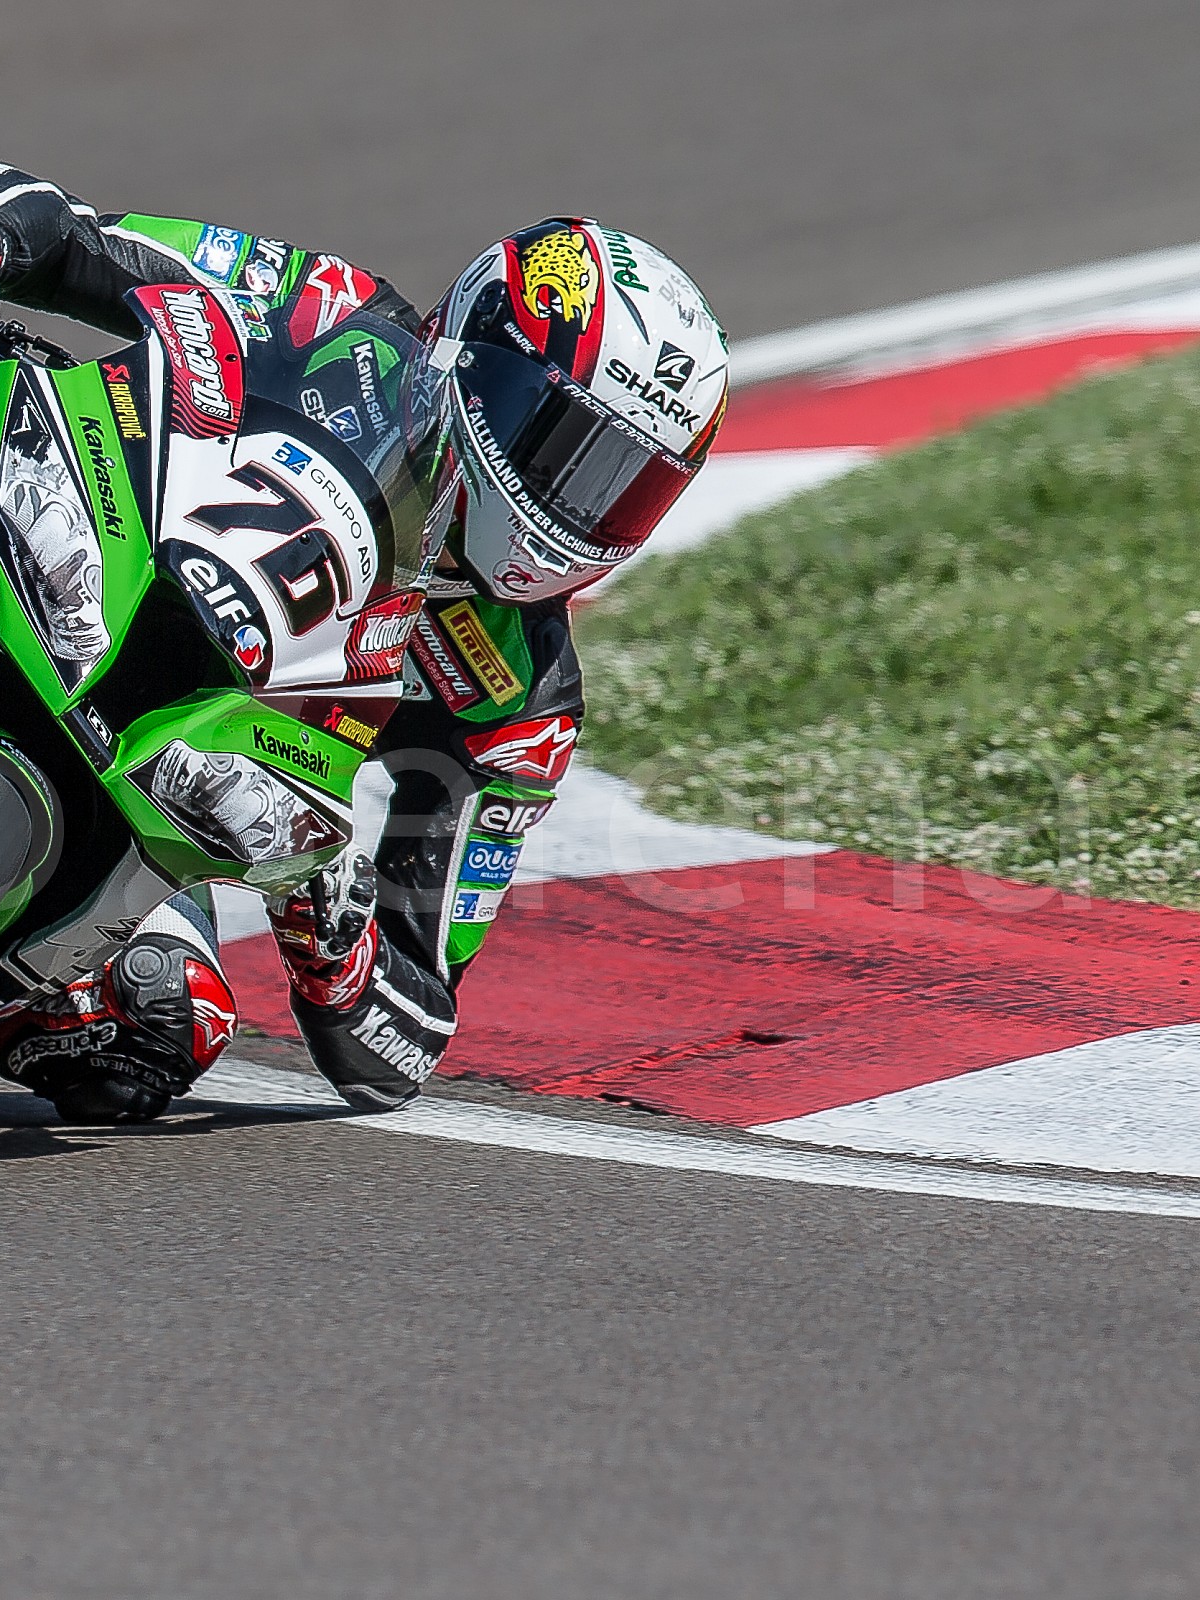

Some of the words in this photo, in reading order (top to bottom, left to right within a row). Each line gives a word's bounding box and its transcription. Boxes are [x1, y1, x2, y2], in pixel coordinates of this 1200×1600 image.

[504, 320, 535, 354] SHARK
[604, 358, 701, 434] SHARK
[77, 415, 128, 541] Kawasaki
[469, 411, 523, 493] ALLIMAND
[515, 490, 553, 530] PAPER
[549, 523, 604, 560] MACHINES
[183, 459, 353, 640] 76
[309, 468, 363, 540] GRUPO
[357, 545, 373, 584] ADI
[180, 558, 252, 624] elf
[449, 607, 516, 694] PIRELLI
[252, 724, 331, 780] Kawasaki
[480, 803, 538, 833] elf
[350, 1004, 441, 1084] Kawas
